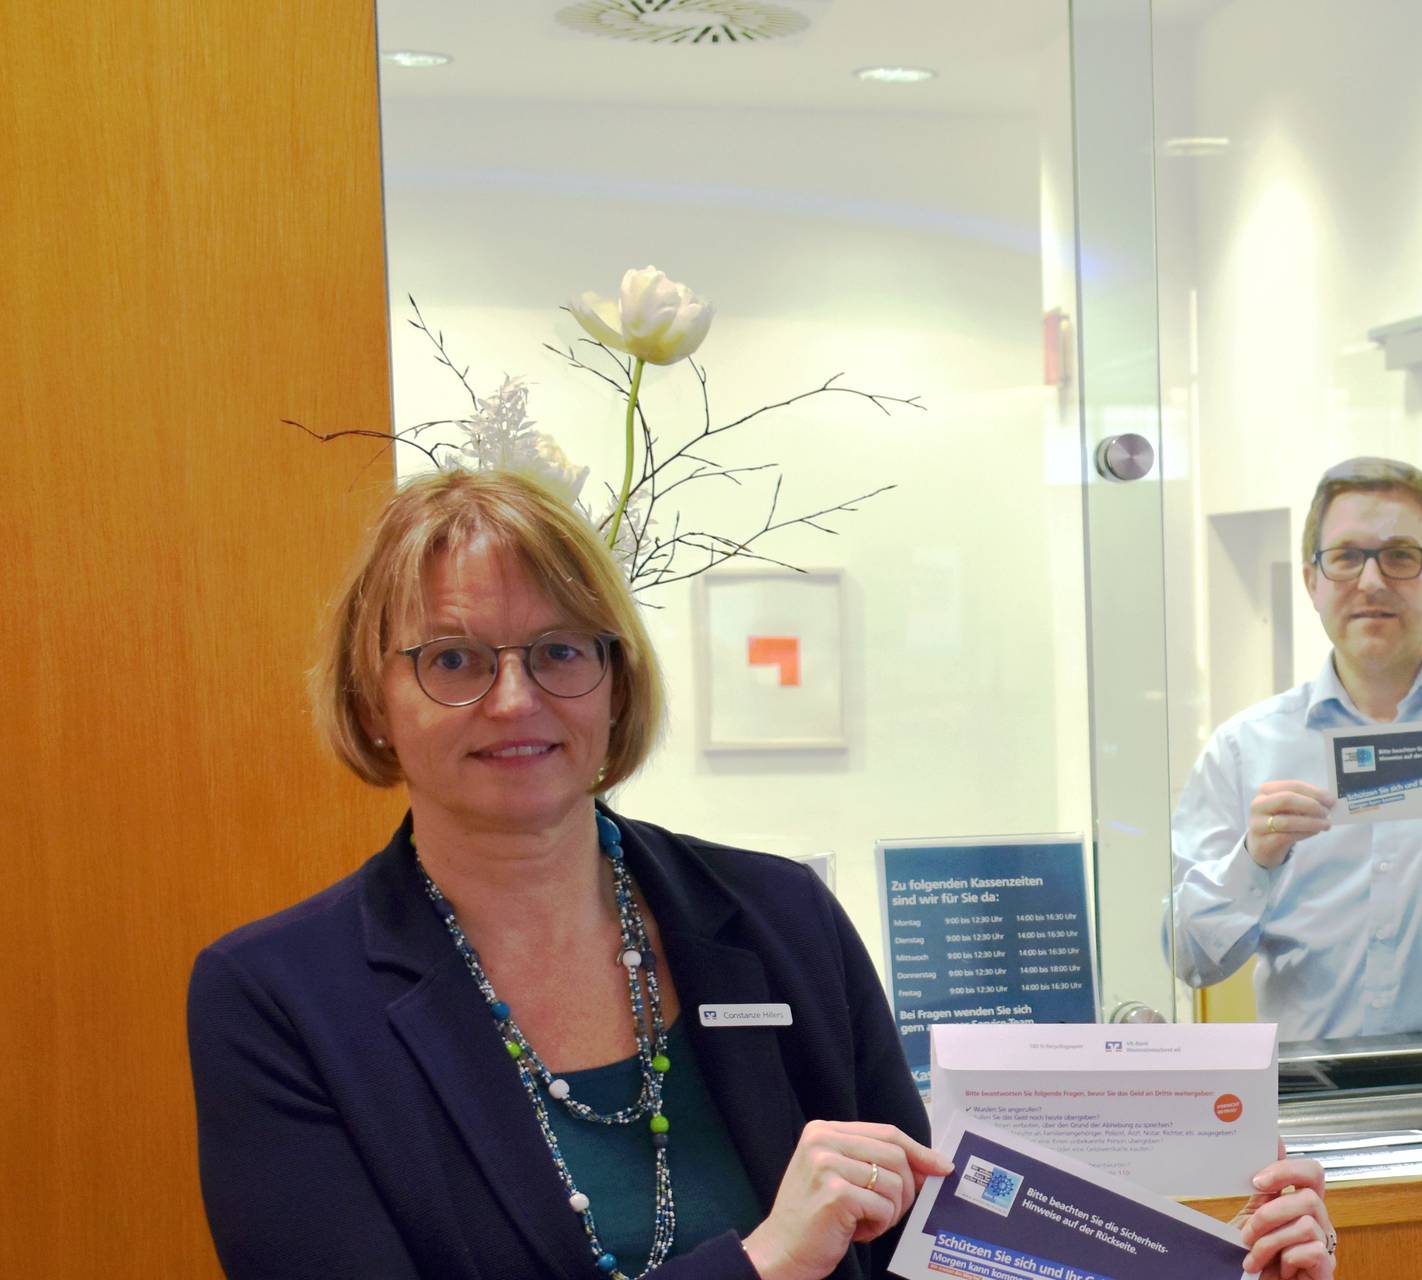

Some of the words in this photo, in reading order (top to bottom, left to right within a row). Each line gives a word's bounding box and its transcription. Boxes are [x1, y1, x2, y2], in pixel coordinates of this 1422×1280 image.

[891, 880, 906, 891] Zu
[909, 879, 968, 892] folgenden
[970, 876, 1043, 888] Kassenzeiten
[893, 894, 917, 906] sind
[919, 894, 939, 905] wir
[941, 893, 958, 904] für
[961, 892, 978, 903] Sie
[980, 891, 1000, 902] da:
[893, 919, 921, 928] Montag
[960, 916, 970, 924] bis
[971, 915, 989, 924] 12:30
[991, 915, 1004, 923] Uhr
[895, 936, 925, 945] Dienstag
[962, 934, 972, 942] bis
[973, 933, 991, 941] 12:30
[992, 932, 1005, 940] Uhr
[974, 951, 992, 959] 12:30
[993, 950, 1006, 958] Uhr
[1067, 947, 1080, 955] Uhr
[897, 972, 937, 980] Donnerstag
[964, 969, 974, 977] bis
[975, 968, 994, 976] 12:30
[994, 967, 1007, 975] Uhr
[1020, 966, 1038, 974] 14:00
[898, 990, 922, 998] Freitag
[996, 985, 1008, 993] Uhr
[1040, 983, 1050, 991] bis
[723, 1011, 761, 1019] Constanze
[900, 1010, 916, 1020] Bei
[917, 1009, 952, 1021] Fragen
[953, 1007, 995, 1018] wenden
[996, 1006, 1011, 1016] Sie
[1013, 1004, 1032, 1015] sich
[901, 1024, 925, 1035] gern
[1034, 1090, 1062, 1098] folgende
[1022, 1199, 1061, 1222] Hinweise
[1062, 1216, 1080, 1229] auf
[1080, 1223, 1095, 1236] der
[1095, 1229, 1137, 1255] Rückseite.
[1026, 1187, 1049, 1203] Bitte
[1049, 1196, 1089, 1221] beachten
[1091, 1214, 1104, 1227] Sie
[1105, 1221, 1119, 1233] die
[1120, 1227, 1169, 1254] Sicherheits-
[932, 1252, 967, 1269] Morgen
[968, 1262, 989, 1275] kann
[938, 1234, 992, 1258] Schützen
[994, 1250, 1012, 1264] Sie
[1014, 1256, 1037, 1271] sich
[1039, 1262, 1064, 1279] und
[1065, 1270, 1083, 1280] Ihr
